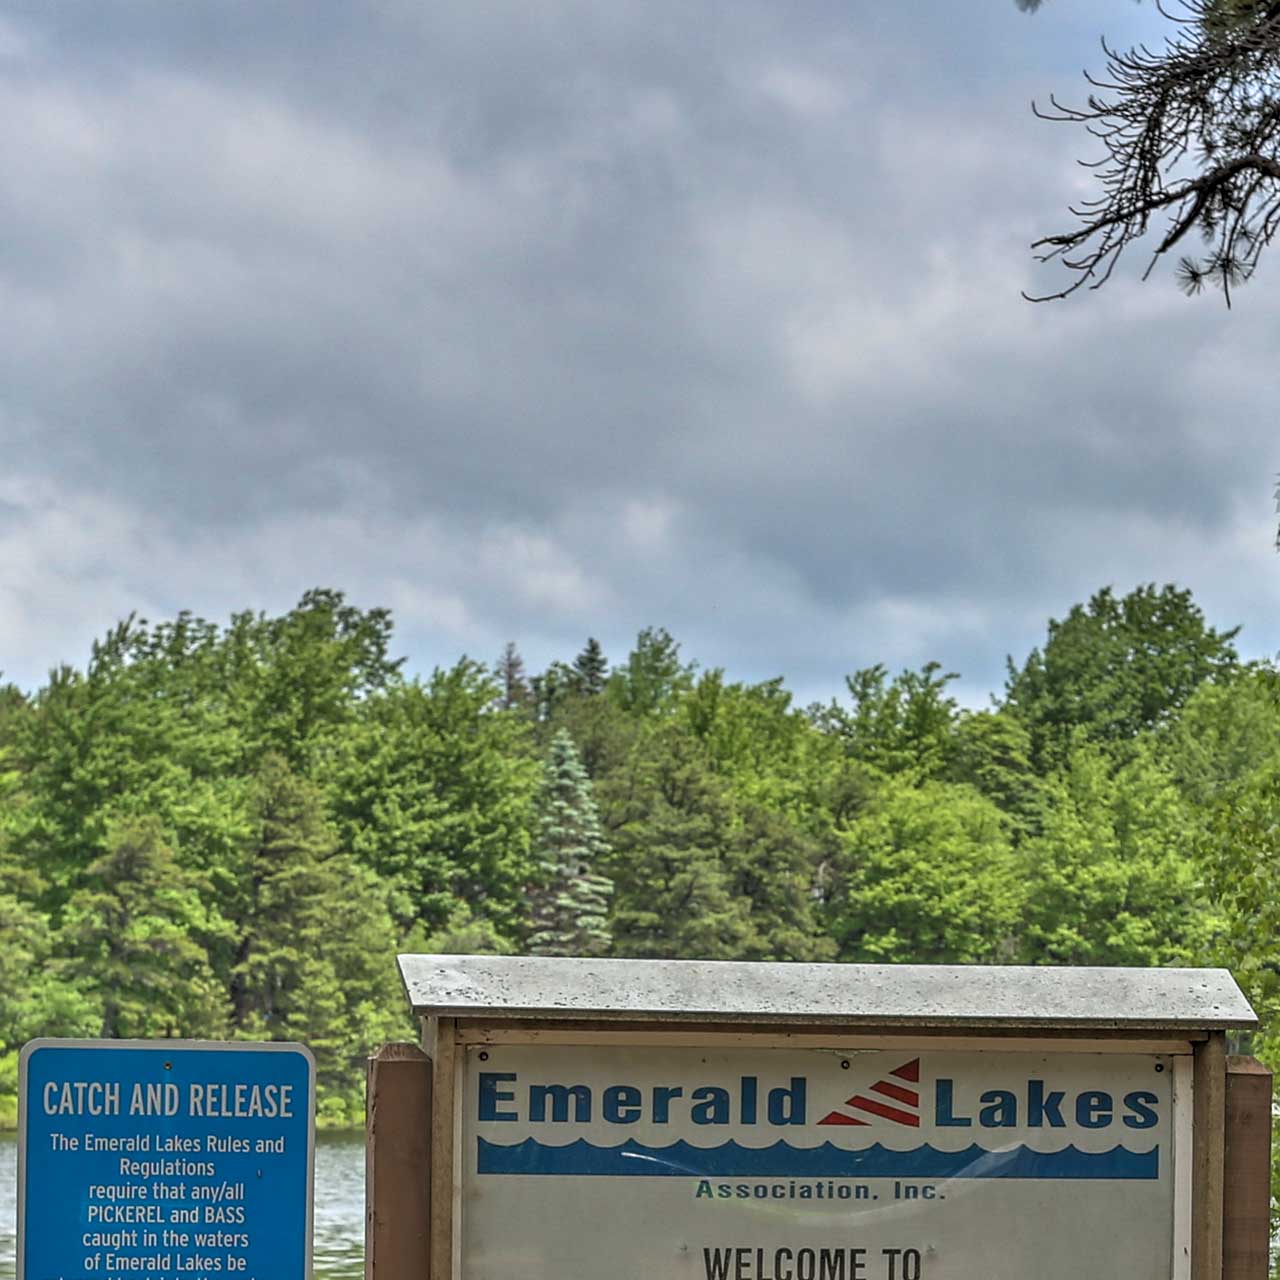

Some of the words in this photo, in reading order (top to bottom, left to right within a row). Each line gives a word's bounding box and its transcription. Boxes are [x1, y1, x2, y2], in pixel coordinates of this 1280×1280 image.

[43, 1081, 119, 1115] CATCH
[129, 1083, 178, 1115] AND
[189, 1083, 292, 1117] RELEASE
[478, 1072, 808, 1125] Emerald
[935, 1078, 1159, 1129] Lakes
[50, 1133, 79, 1150] The
[85, 1133, 149, 1151] Emerald
[155, 1134, 201, 1152] Lakes
[207, 1135, 250, 1152] Rules
[255, 1136, 284, 1153] and
[119, 1158, 214, 1179] Regulations
[89, 1181, 147, 1202] require
[152, 1182, 186, 1199] that
[191, 1181, 243, 1203] any/all
[894, 1181, 945, 1199] Inc.
[88, 1205, 165, 1222] PICKEREL
[169, 1206, 198, 1223] and
[204, 1206, 244, 1223] BASS
[82, 1229, 137, 1250] caught
[143, 1229, 157, 1246] in
[162, 1230, 189, 1247] the
[194, 1230, 248, 1247] waters
[84, 1252, 100, 1270] of
[106, 1253, 170, 1270] Emerald
[176, 1253, 221, 1270] Lakes
[227, 1254, 246, 1270] be
